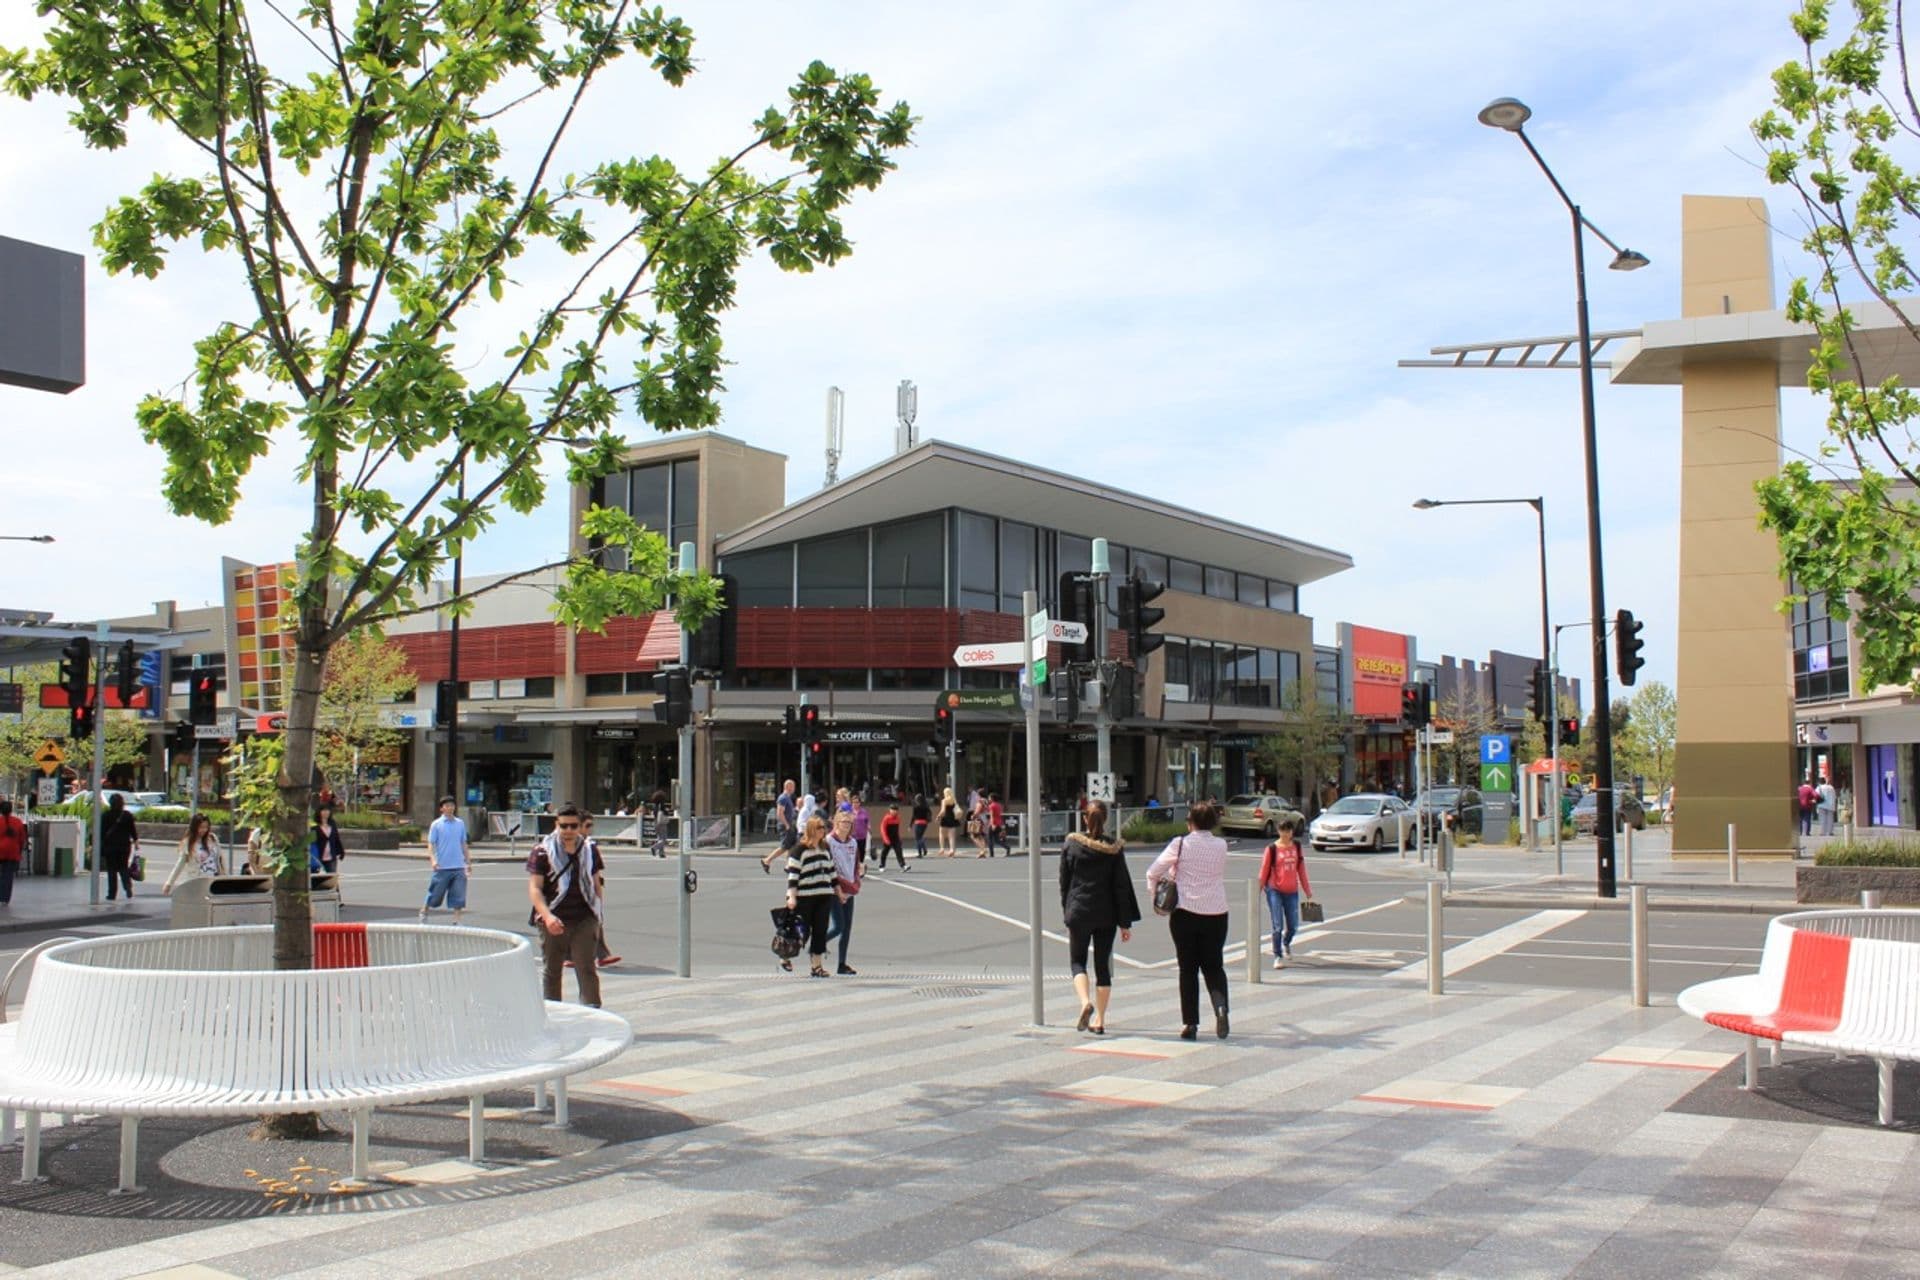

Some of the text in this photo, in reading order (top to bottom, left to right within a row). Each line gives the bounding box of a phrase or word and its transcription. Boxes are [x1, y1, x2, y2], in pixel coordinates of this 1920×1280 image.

[963, 650, 994, 662] coles
[840, 732, 871, 740] COFFEE
[1488, 740, 1503, 760] P
